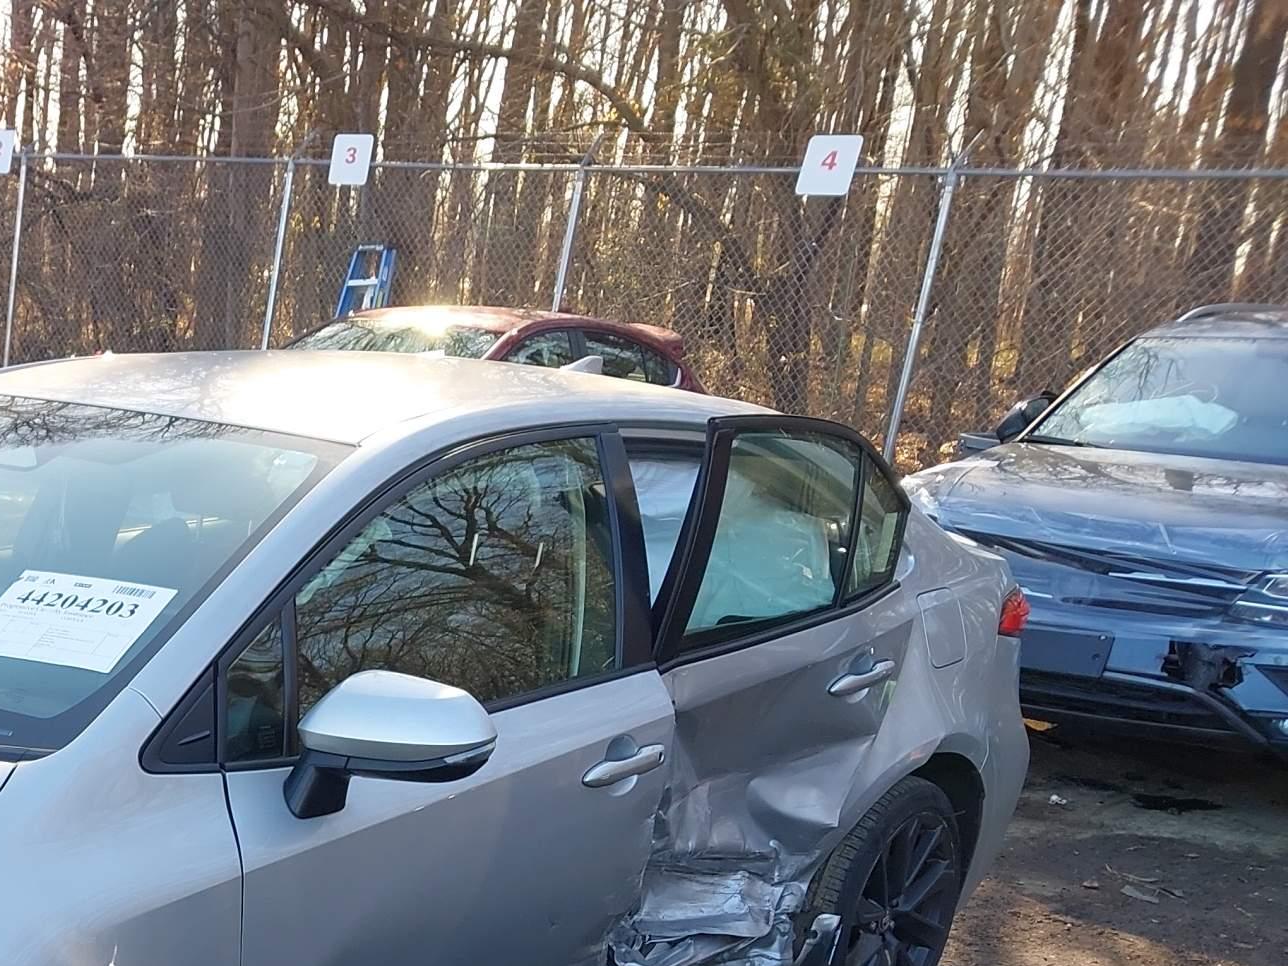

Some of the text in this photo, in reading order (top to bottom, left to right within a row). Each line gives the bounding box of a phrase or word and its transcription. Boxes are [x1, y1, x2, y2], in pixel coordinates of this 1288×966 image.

[345, 147, 357, 164] 3
[821, 151, 838, 170] 4
[16, 589, 140, 619] 44204203
